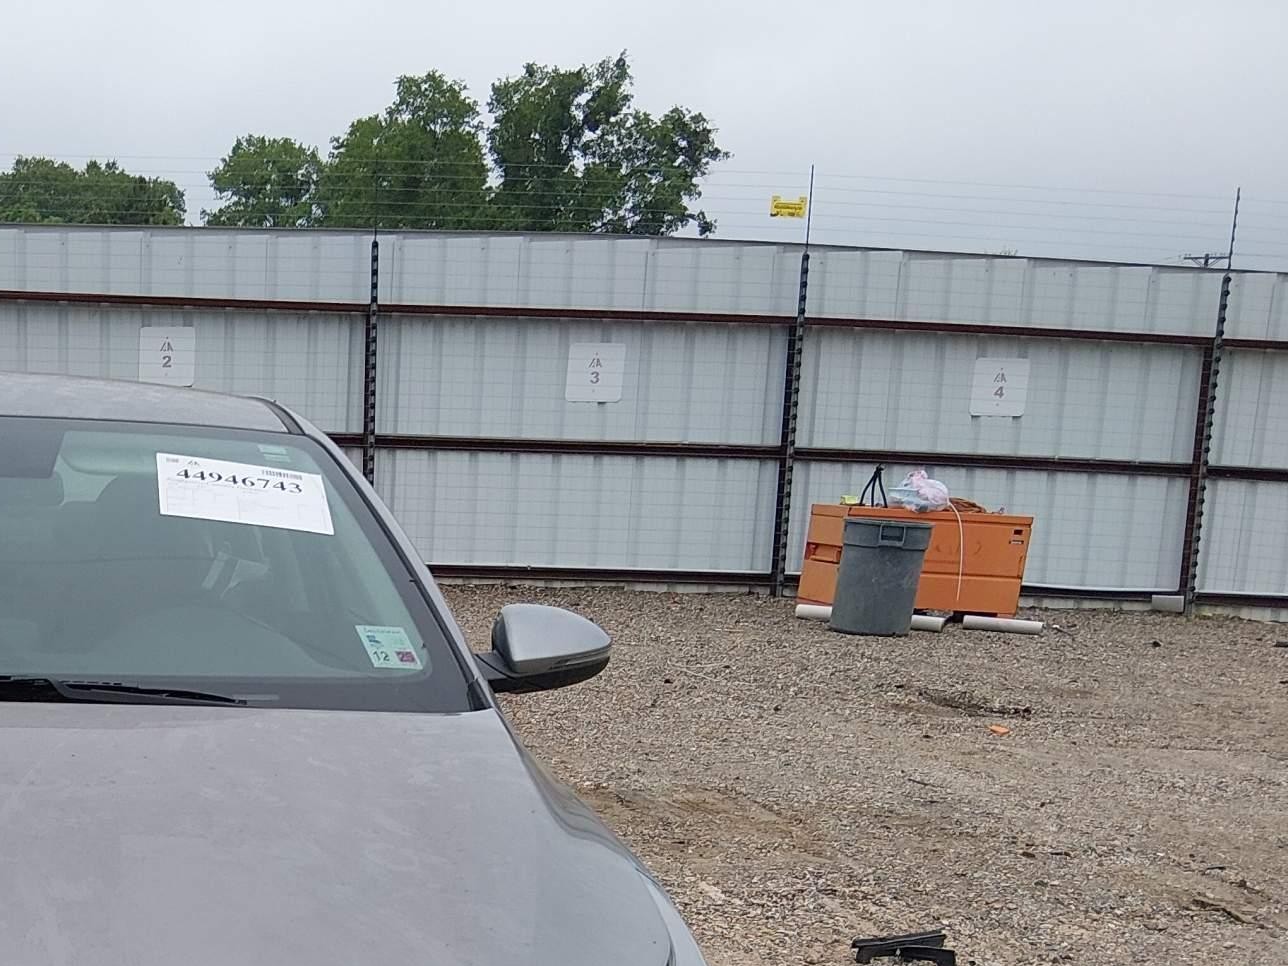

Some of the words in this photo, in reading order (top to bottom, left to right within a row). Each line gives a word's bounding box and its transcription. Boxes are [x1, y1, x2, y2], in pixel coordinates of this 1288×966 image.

[162, 355, 172, 368] 2
[590, 371, 600, 384] 3
[993, 386, 1005, 399] 4
[176, 468, 303, 494] 44946743
[373, 650, 391, 662] 12
